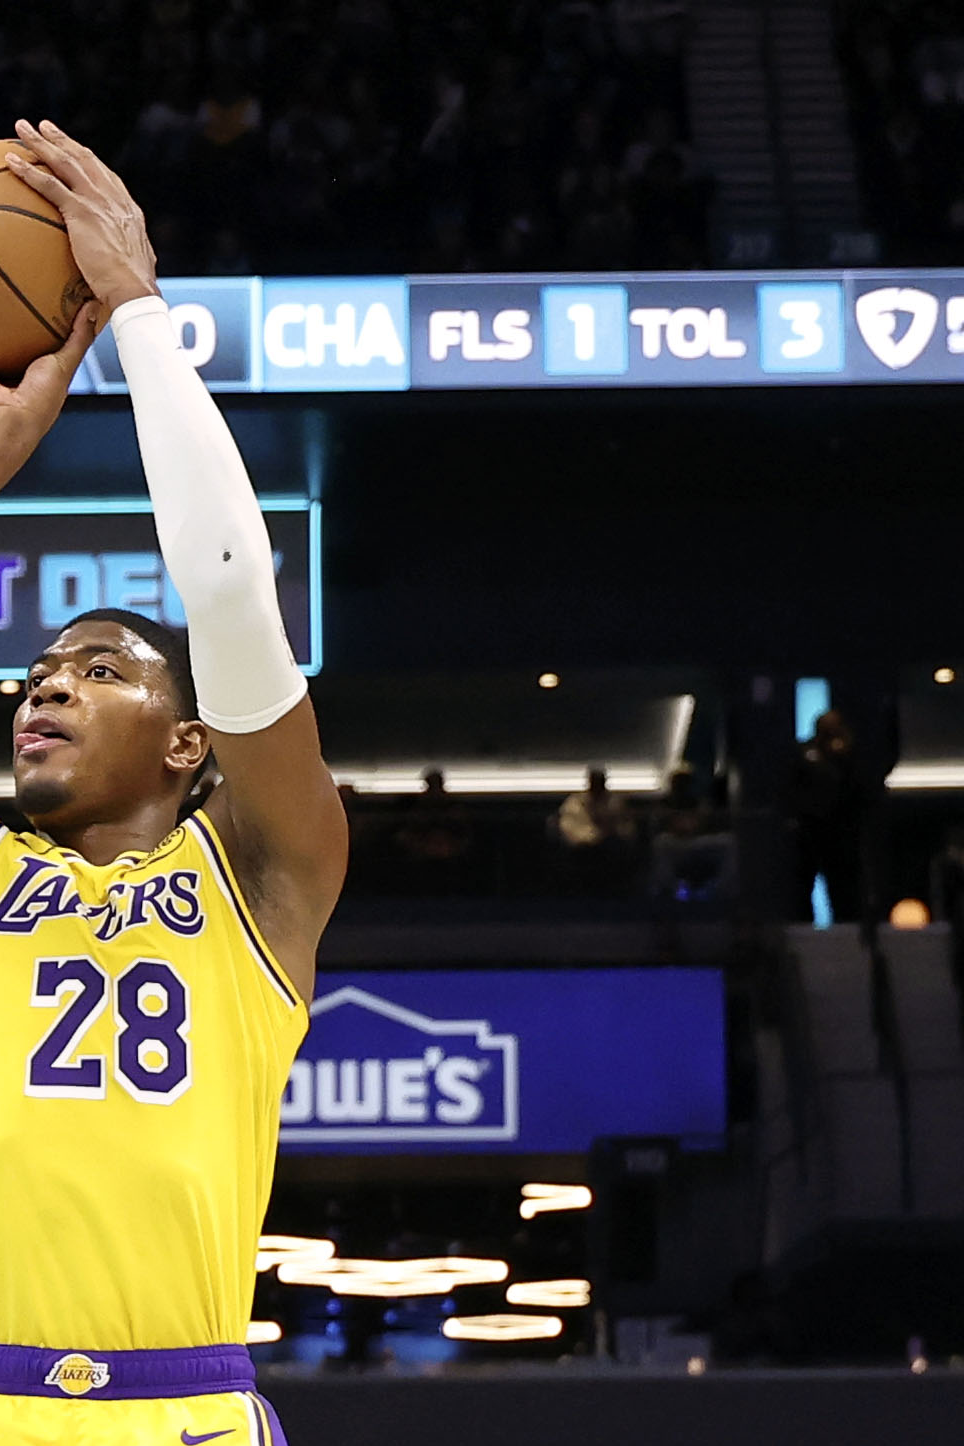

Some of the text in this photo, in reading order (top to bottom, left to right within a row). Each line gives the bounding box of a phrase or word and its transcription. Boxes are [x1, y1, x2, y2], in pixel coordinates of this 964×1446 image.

[262, 302, 406, 368] CHA
[427, 300, 825, 362] FLS 1 TOL 3
[38, 549, 284, 630] DE
[23, 953, 194, 1106] 28
[279, 1046, 485, 1124] OWE'S
